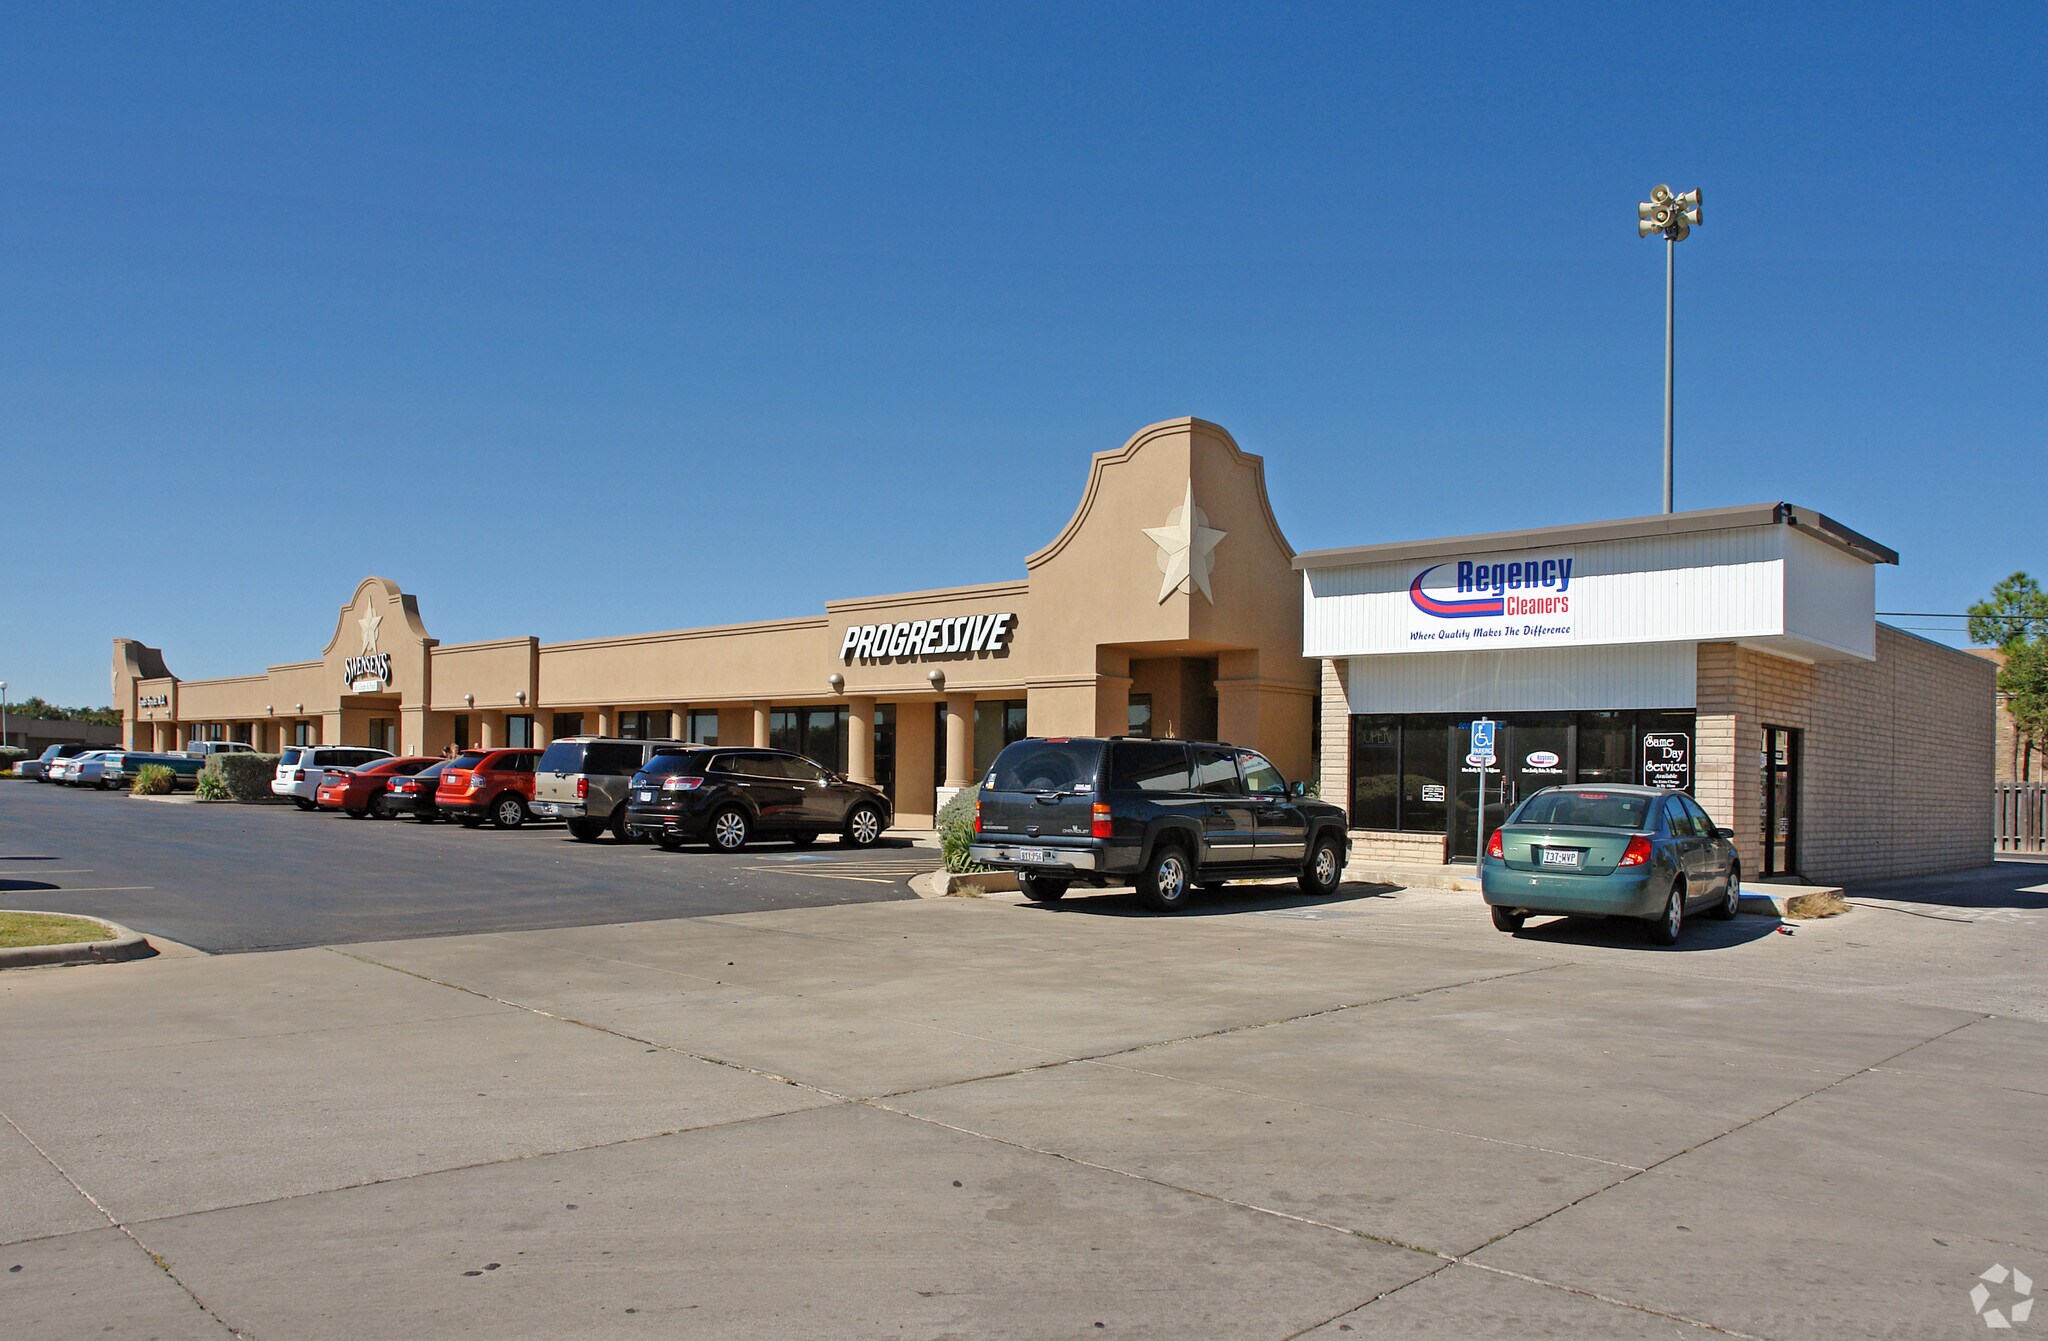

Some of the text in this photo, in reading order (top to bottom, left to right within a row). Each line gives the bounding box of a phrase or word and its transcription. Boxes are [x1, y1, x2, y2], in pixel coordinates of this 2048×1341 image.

[1457, 558, 1572, 596] Regency
[1507, 596, 1569, 616] Cleaners
[838, 612, 1012, 660] PROGRESSIVE
[1410, 625, 1571, 641] Where Quality Makes The Difference
[1646, 736, 1674, 747] Same
[1662, 747, 1685, 762] Day
[1645, 760, 1687, 772] Service
